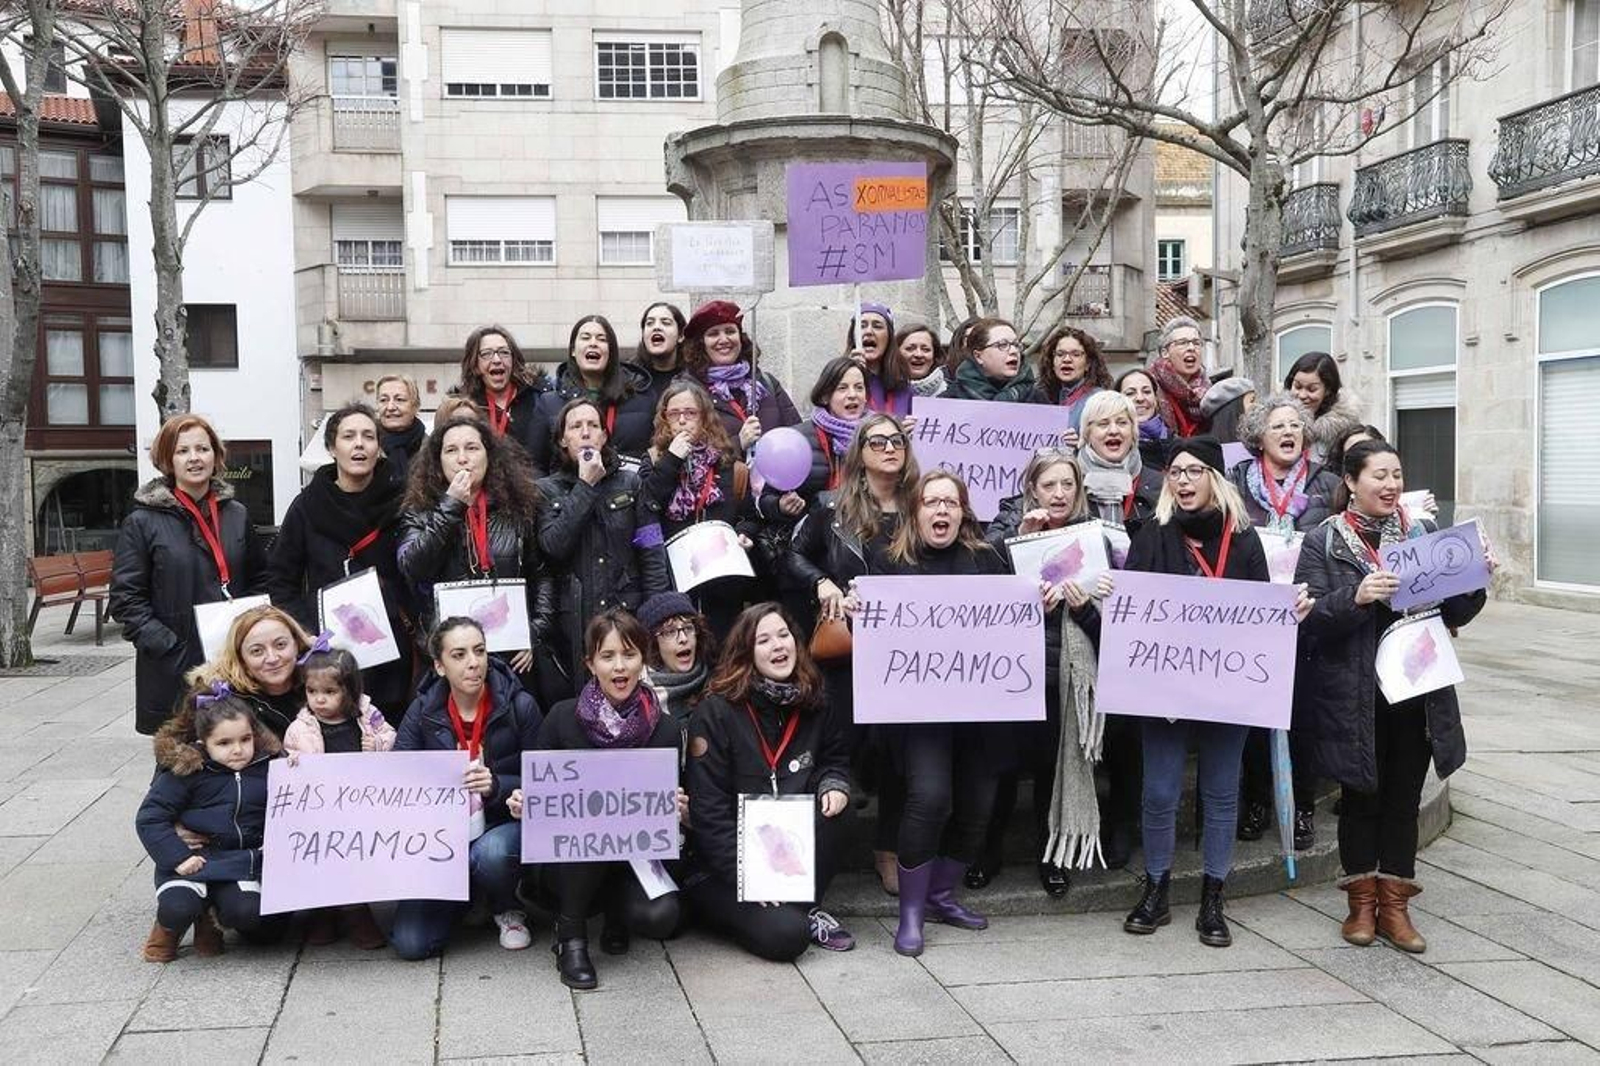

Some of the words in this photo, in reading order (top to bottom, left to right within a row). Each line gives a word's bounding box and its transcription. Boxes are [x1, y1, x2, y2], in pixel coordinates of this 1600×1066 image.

[806, 181, 848, 211] AS
[820, 211, 925, 242] PARAMOS
[816, 242, 896, 277] #8M
[916, 418, 972, 445] #AS
[859, 600, 919, 628] #AS
[922, 602, 1042, 628] XORNALISTAS
[1110, 595, 1169, 623] #AS
[1173, 603, 1298, 626] XORNALISTAS
[883, 650, 1032, 693] PARAMOS
[1128, 639, 1269, 684] PARAMOS
[531, 760, 580, 783] LAS
[271, 784, 325, 818] #AS
[334, 785, 468, 811] XORNALISTAS
[288, 828, 454, 866] PARAMOS
[553, 829, 672, 858] PARAMOS
